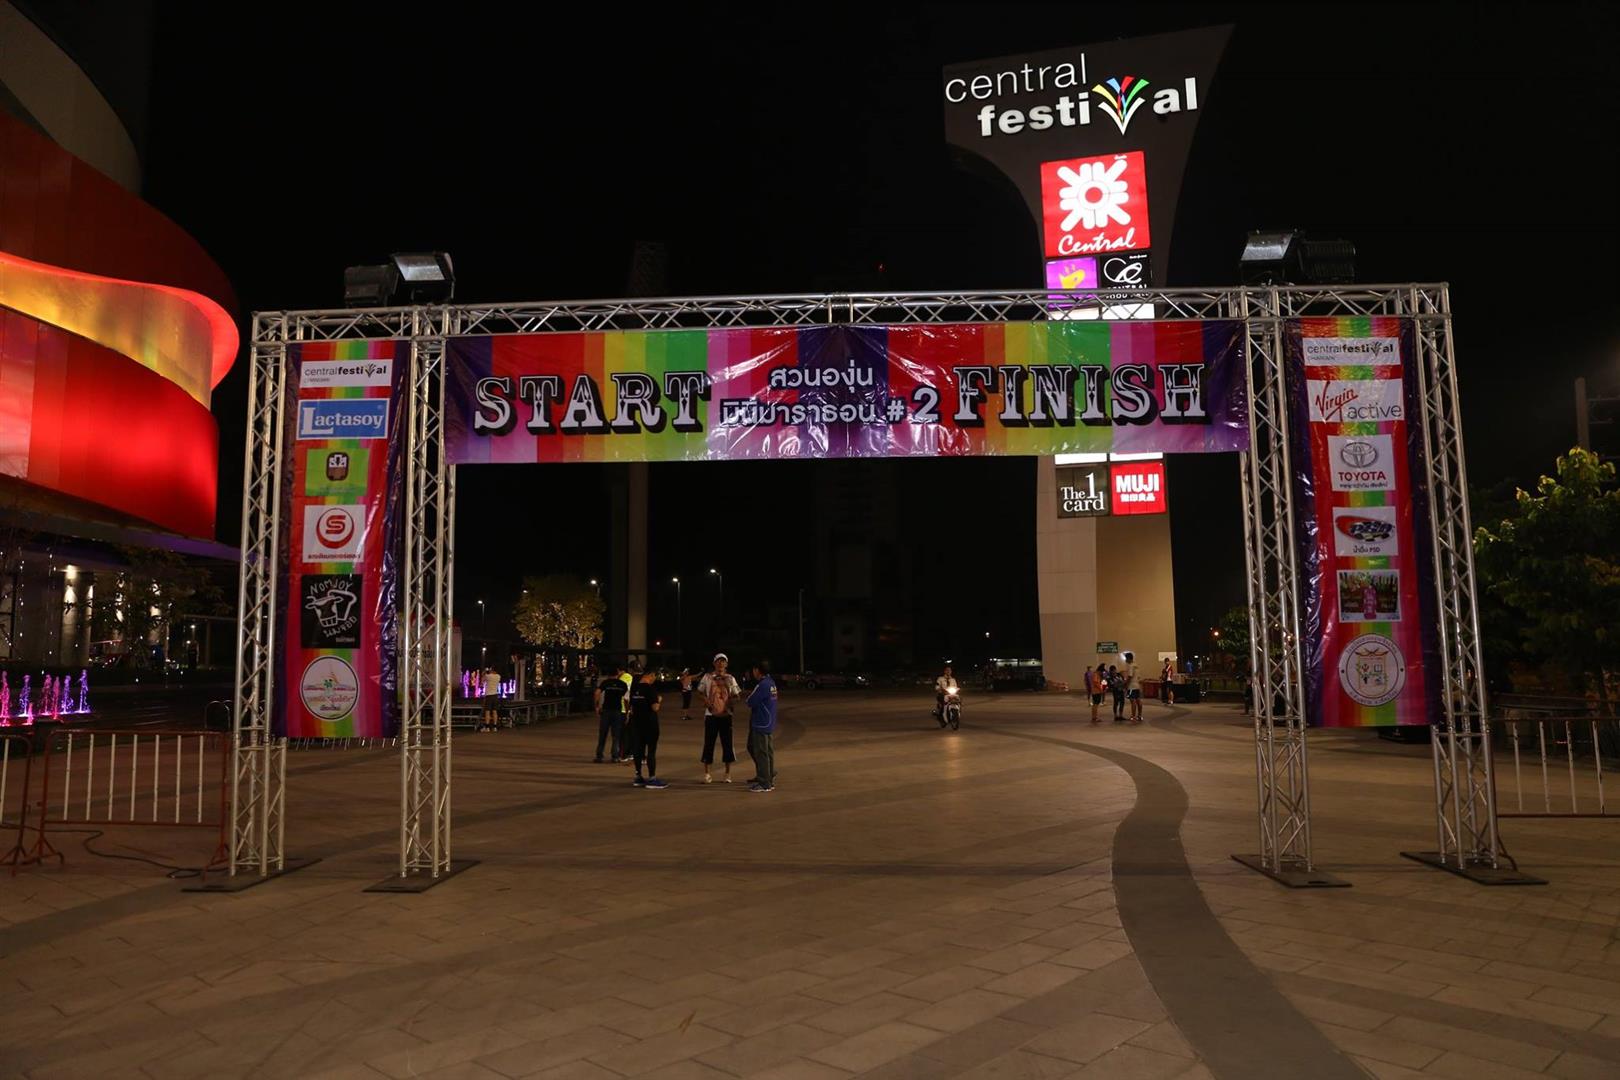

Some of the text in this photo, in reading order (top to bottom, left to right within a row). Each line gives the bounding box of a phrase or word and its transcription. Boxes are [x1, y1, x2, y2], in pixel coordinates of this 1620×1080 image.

[945, 53, 1087, 103] central
[977, 76, 1198, 137] festival
[1058, 227, 1136, 255] Central
[770, 360, 873, 393] สวนองุ่น
[474, 371, 711, 435] START
[953, 363, 1211, 428] FINISH
[1315, 381, 1358, 422] Virgin
[301, 407, 384, 435] Lactasoy
[1347, 404, 1402, 420] active
[1061, 486, 1085, 500] The
[1085, 472, 1098, 499] 1
[1115, 473, 1160, 493] MUJI
[1338, 471, 1386, 481] TOYOTA
[1063, 491, 1105, 512] card
[310, 578, 353, 596] NOMJOY
